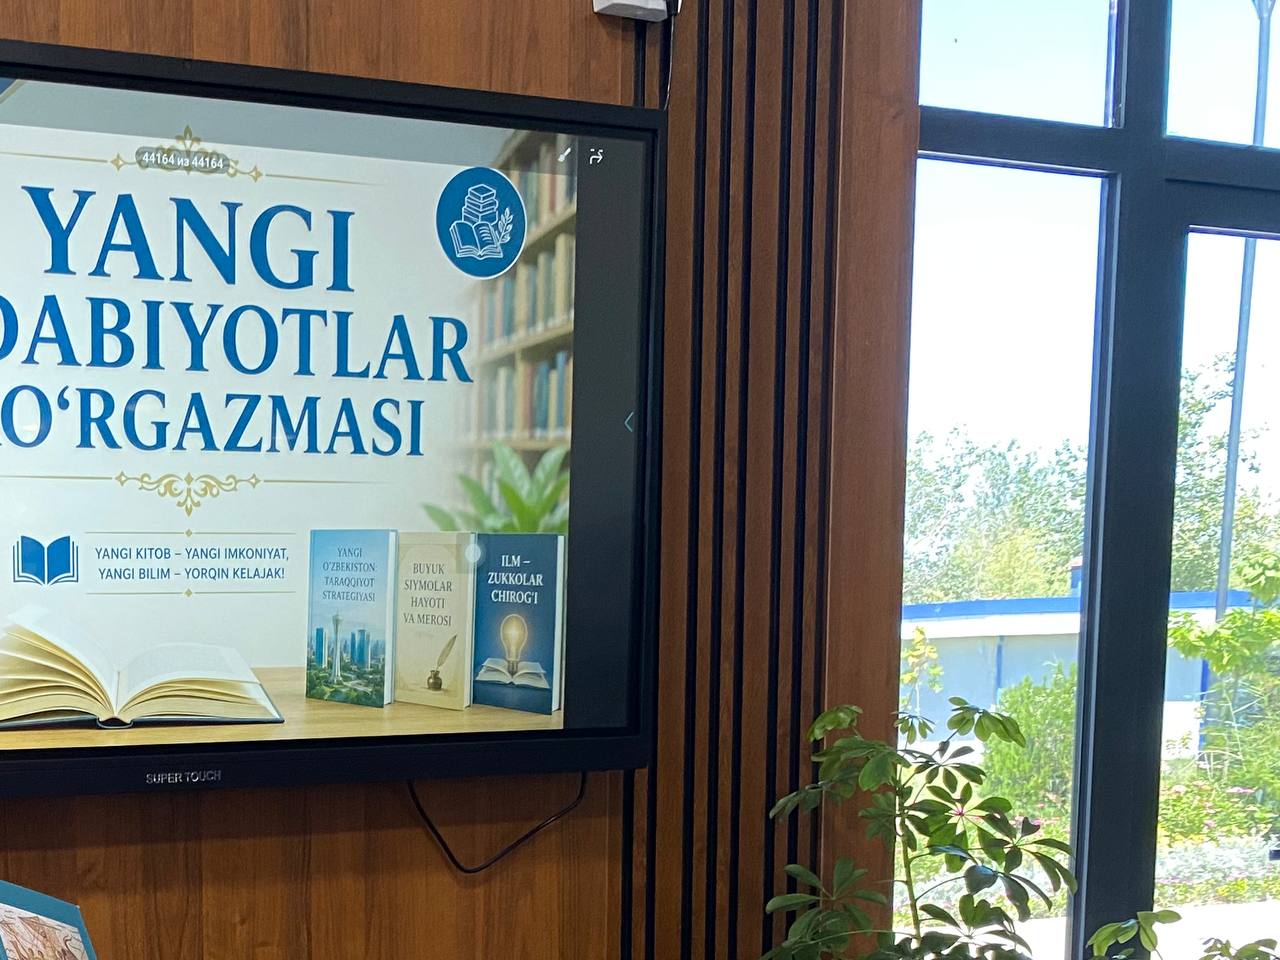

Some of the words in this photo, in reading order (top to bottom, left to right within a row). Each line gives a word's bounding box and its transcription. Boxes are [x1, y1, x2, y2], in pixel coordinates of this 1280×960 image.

[142, 151, 175, 165] 44164
[177, 157, 190, 167] из
[191, 156, 223, 169] 44164
[21, 186, 355, 292] YANGI
[95, 548, 132, 560] YANGI
[136, 548, 171, 560] KITOB
[185, 548, 221, 560] YANGI
[224, 548, 289, 561] IMKONIYAT,
[337, 547, 362, 558] YANGI
[501, 554, 520, 567] ILM
[99, 567, 135, 580] YANGI
[139, 567, 170, 580] BILIM
[184, 567, 229, 581] YORQIN
[233, 567, 285, 580] KELAJAK!
[413, 562, 444, 575] BUYUK
[325, 576, 375, 588] TARAQQIYOT
[404, 580, 452, 592] SIYMOLAR
[488, 573, 544, 586] ZUKKOLAR
[322, 590, 376, 602] STRATEGIYASI
[411, 596, 445, 609] HAYOTI
[404, 613, 415, 624] VA
[417, 614, 452, 626] MEROSI
[146, 772, 182, 784] SUPER
[184, 770, 221, 782] TOUCH
